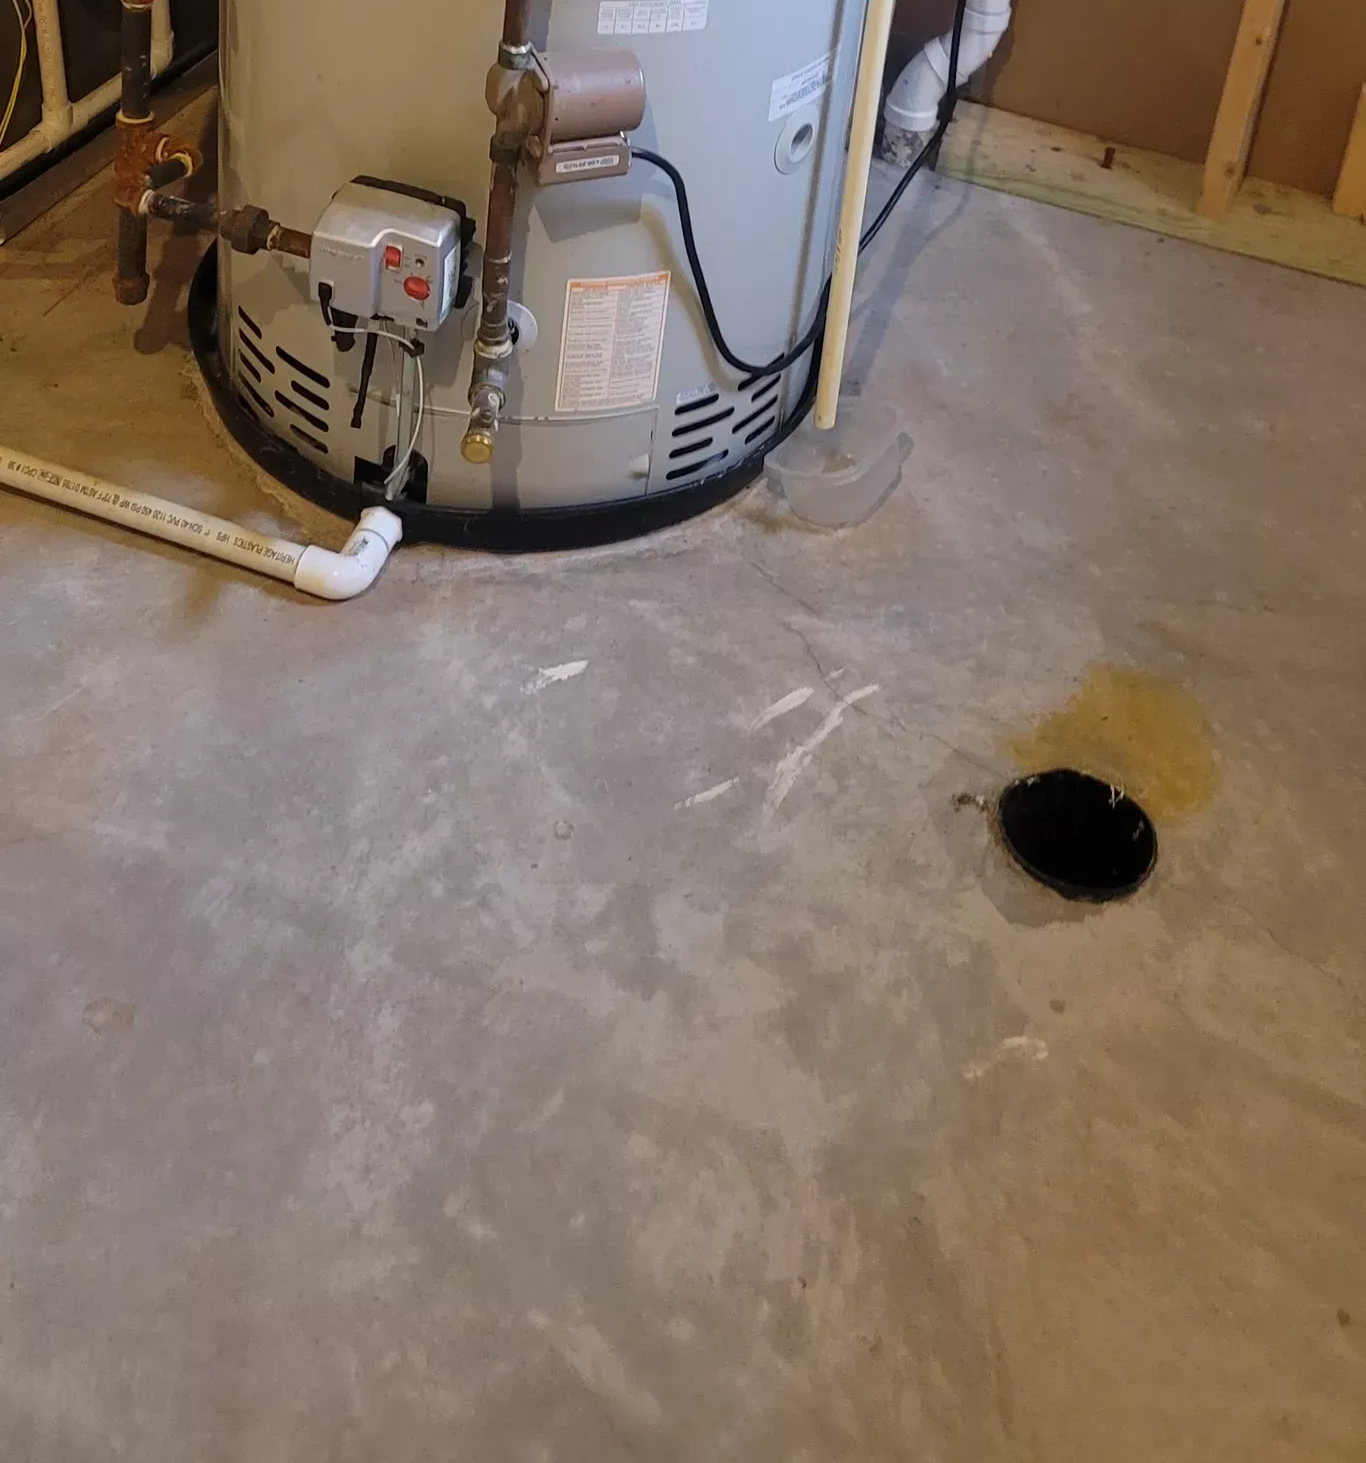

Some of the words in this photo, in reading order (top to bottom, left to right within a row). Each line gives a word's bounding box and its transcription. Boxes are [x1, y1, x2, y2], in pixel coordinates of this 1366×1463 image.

[78, 484, 98, 499] ASTM
[117, 497, 131, 510] WP
[129, 501, 142, 513] PSI
[139, 504, 153, 517] 450
[151, 509, 167, 522] 1120
[165, 513, 181, 528] PVC
[214, 530, 230, 545] HPS
[232, 535, 263, 556] PLASTICS
[261, 545, 295, 566] HERITAGE
